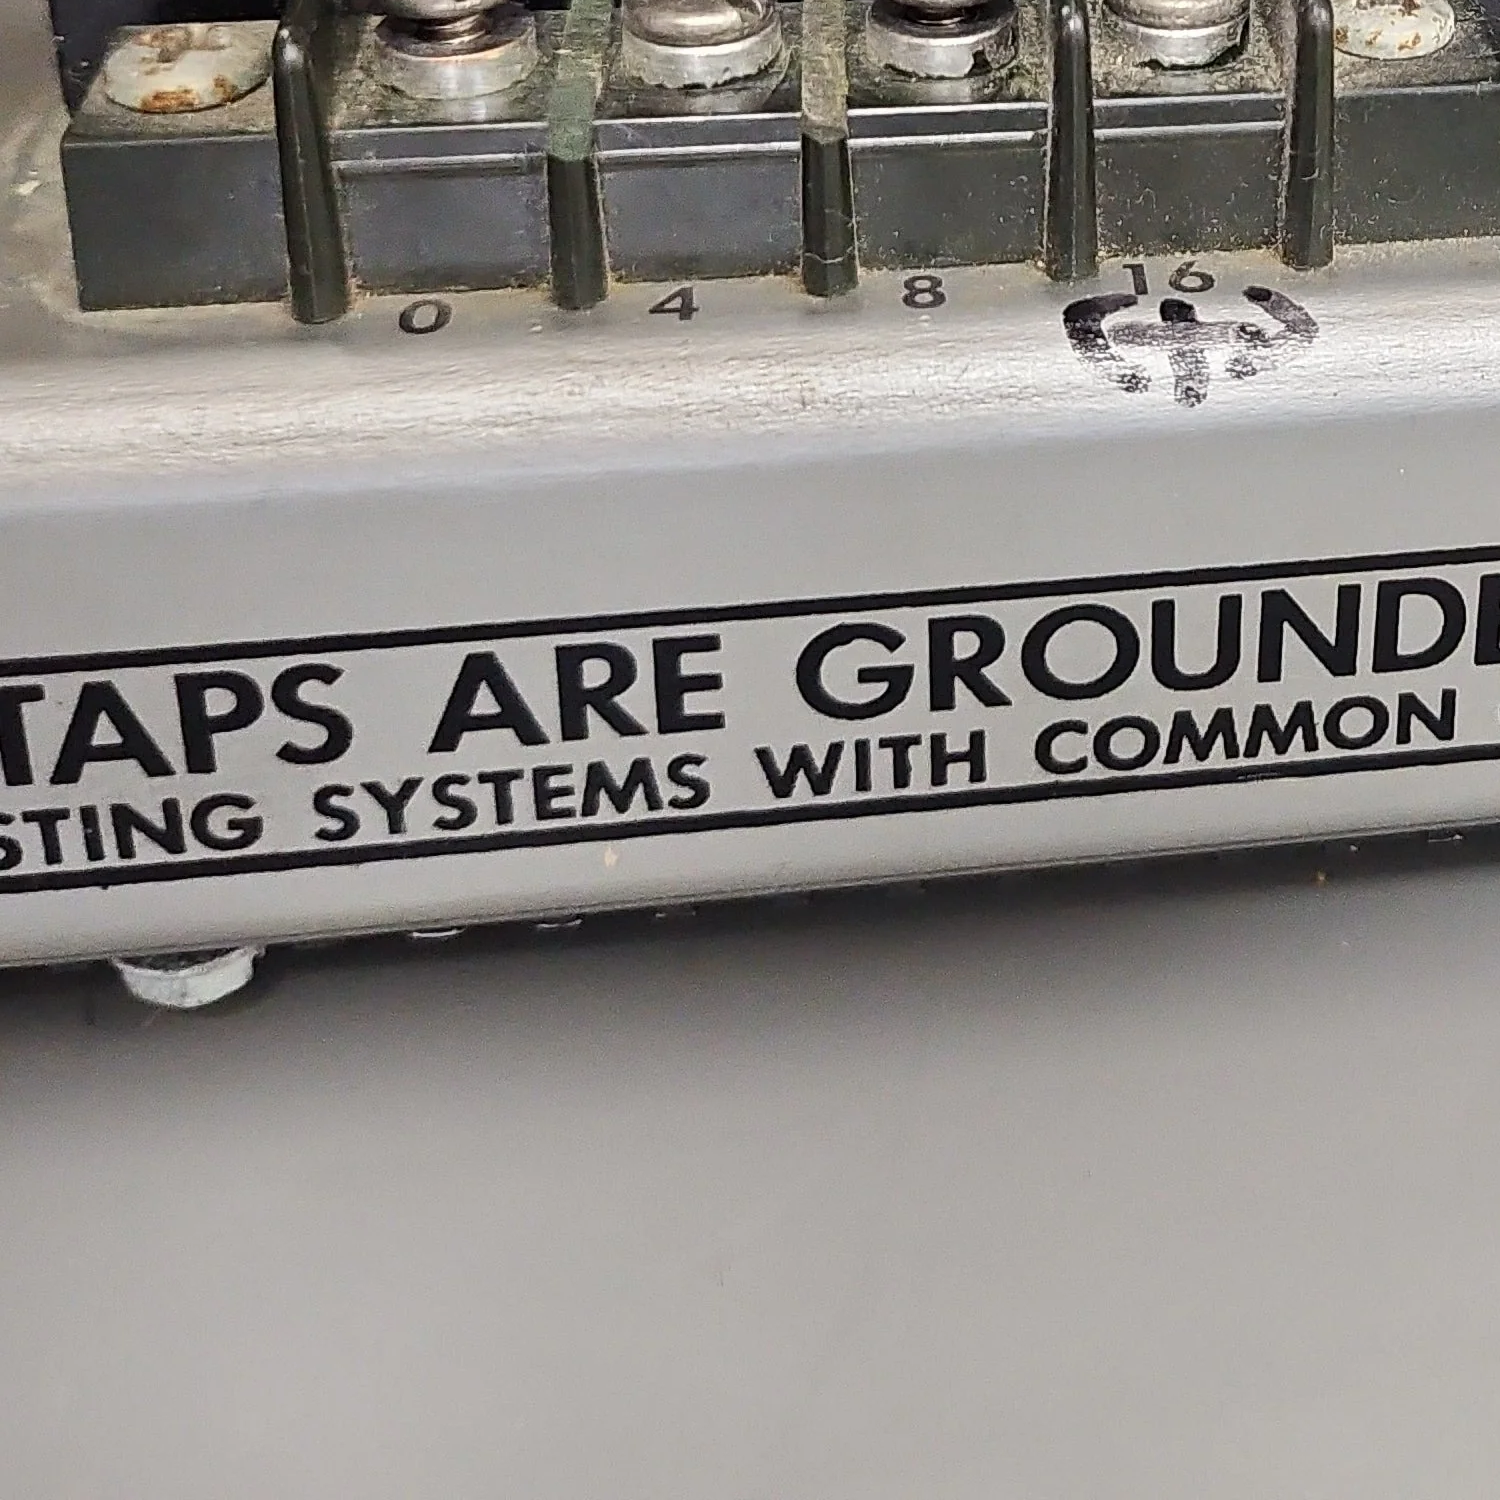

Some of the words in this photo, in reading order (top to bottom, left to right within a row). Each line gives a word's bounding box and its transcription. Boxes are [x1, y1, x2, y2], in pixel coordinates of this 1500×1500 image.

[399, 300, 452, 335] 0
[648, 286, 699, 321] 4
[901, 274, 947, 309] 8
[1122, 260, 1216, 296] 16
[0, 664, 353, 787] TAPS
[428, 635, 726, 754] ARE
[313, 754, 711, 843] SYSTEMS
[754, 730, 987, 799] WITH
[1034, 689, 1457, 775] COMMON
